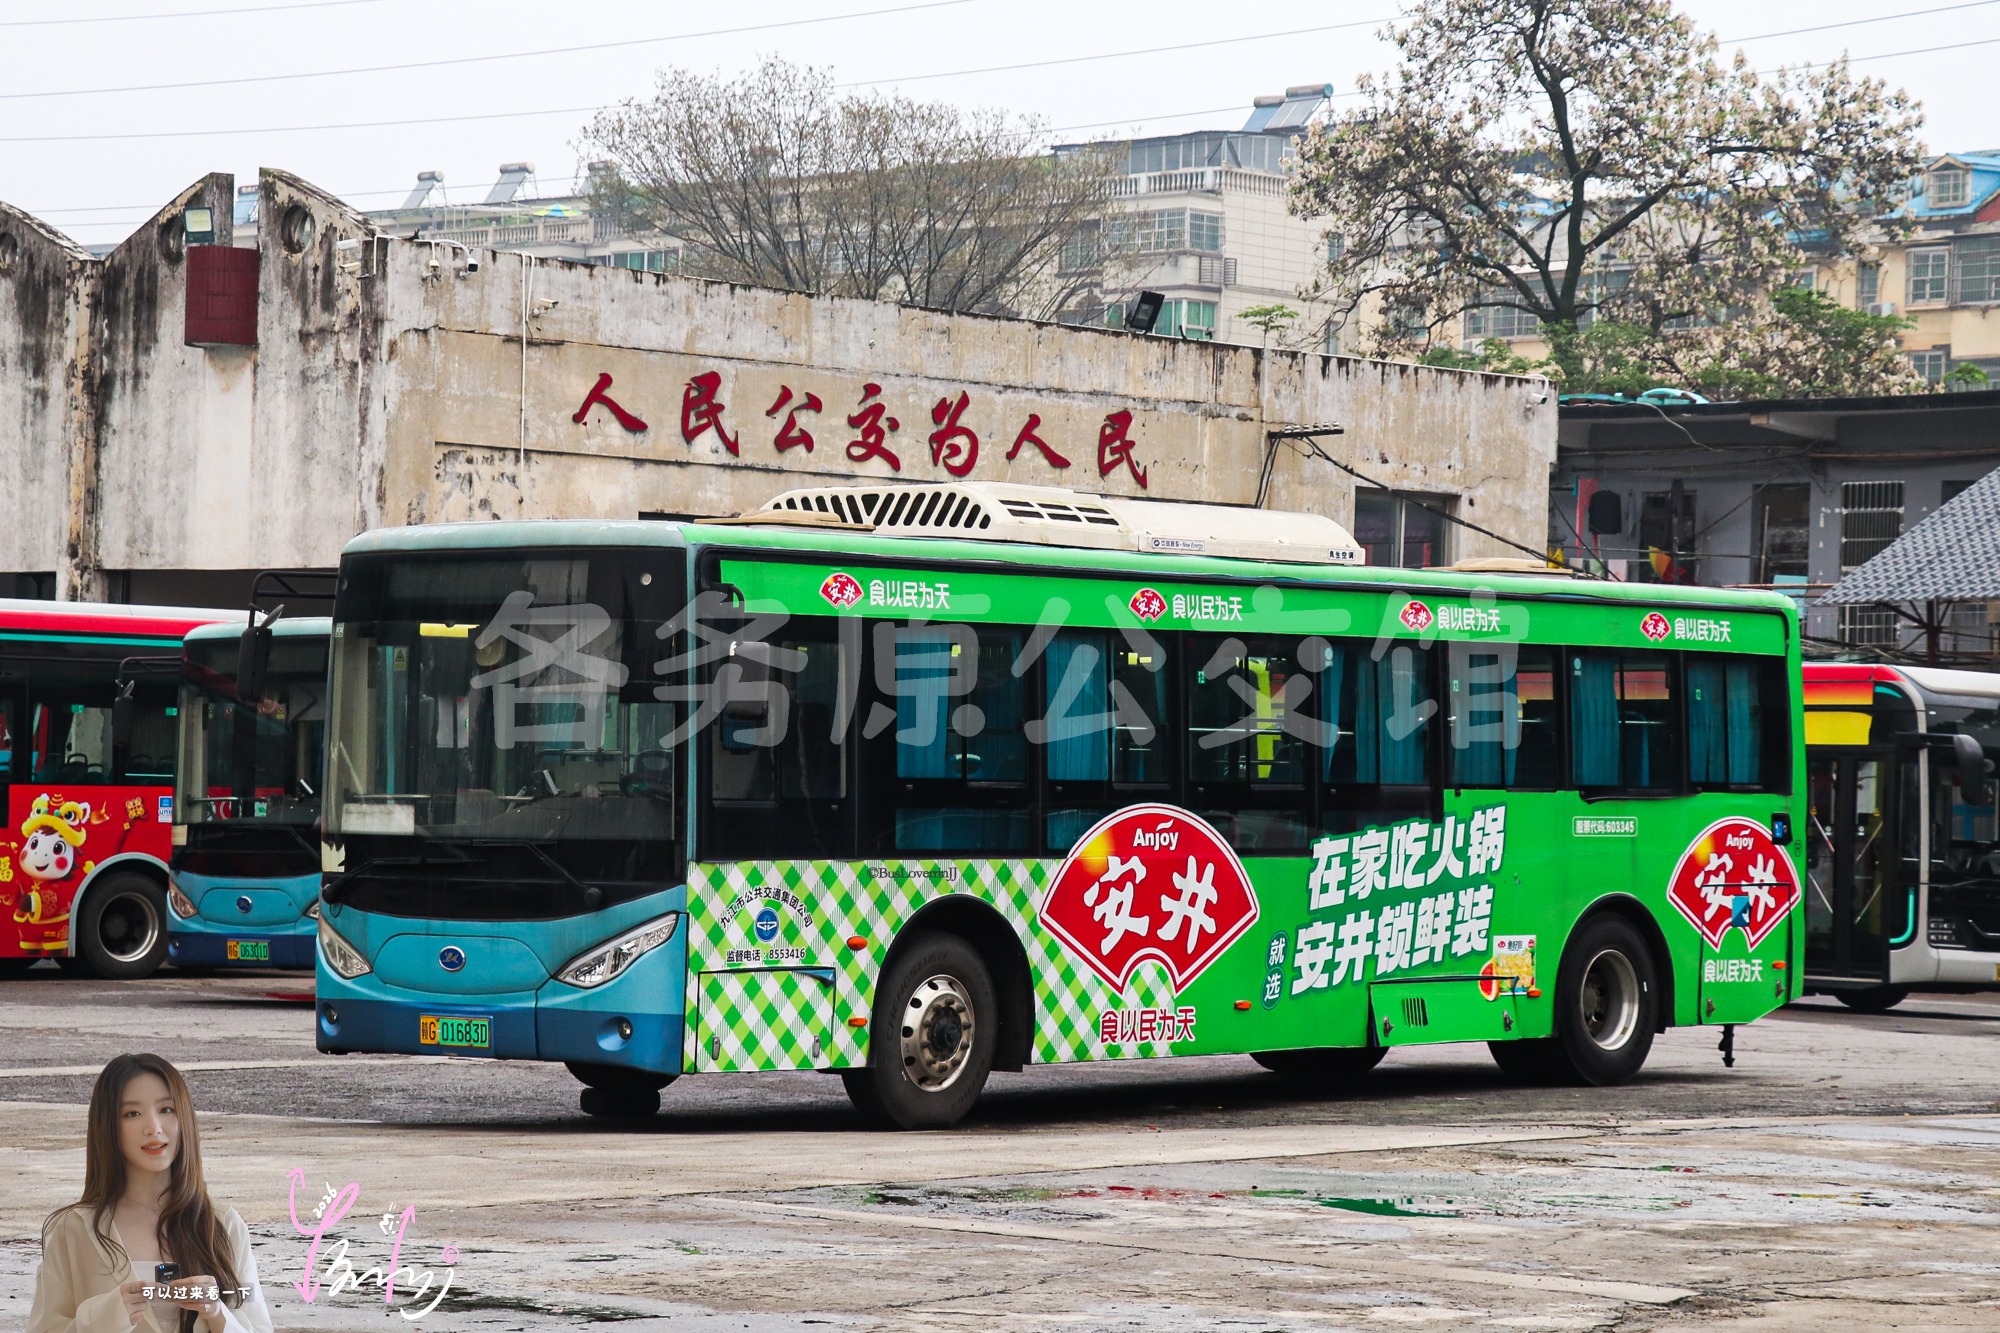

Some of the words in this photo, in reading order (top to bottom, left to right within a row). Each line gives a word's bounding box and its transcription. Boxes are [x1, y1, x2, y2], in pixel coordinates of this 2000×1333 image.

[573, 371, 1148, 489] 人民公交为人民
[827, 582, 856, 601] 安井
[869, 579, 951, 609] 食以民为天
[1136, 597, 1161, 615] 安井
[1172, 593, 1243, 621] 食以民为天
[1437, 606, 1501, 632] 食以民为天
[1674, 617, 1731, 642] 食以民为天
[1133, 819, 1179, 851] Anjoy
[1726, 829, 1754, 850] Anjoy
[1309, 806, 1506, 911] 在家吃火锅
[1694, 853, 1777, 922] 安井
[720, 886, 813, 928] 九江市公共交通集团公司
[1083, 855, 1218, 956] 安井
[1291, 884, 1494, 995] 安井锁鲜装
[1264, 937, 1286, 1002] 就选
[1704, 959, 1762, 982] 食以民为天
[1100, 1008, 1195, 1043] 食以民为天
